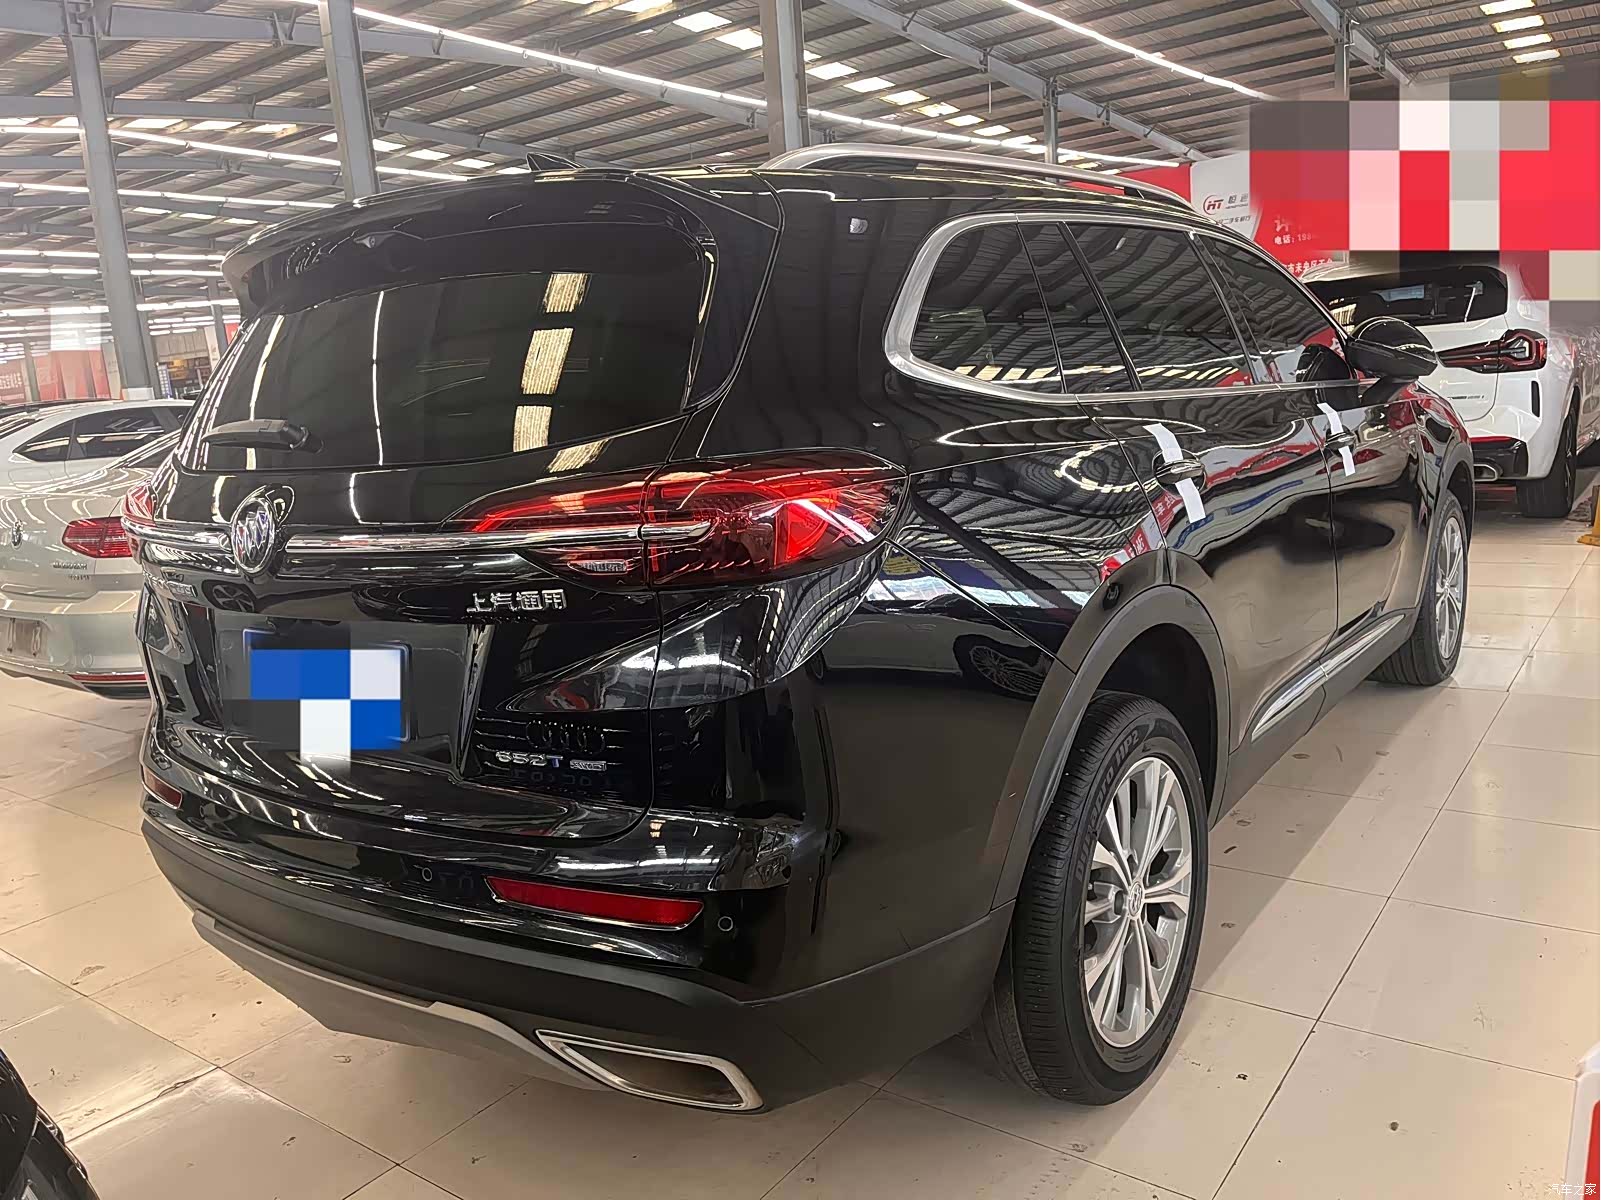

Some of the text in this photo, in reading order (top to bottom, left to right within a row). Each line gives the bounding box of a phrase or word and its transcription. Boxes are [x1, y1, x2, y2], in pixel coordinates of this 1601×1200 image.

[466, 588, 567, 613] 上汽通用
[495, 750, 564, 768] 652T
[1114, 729, 1140, 767] HP2
